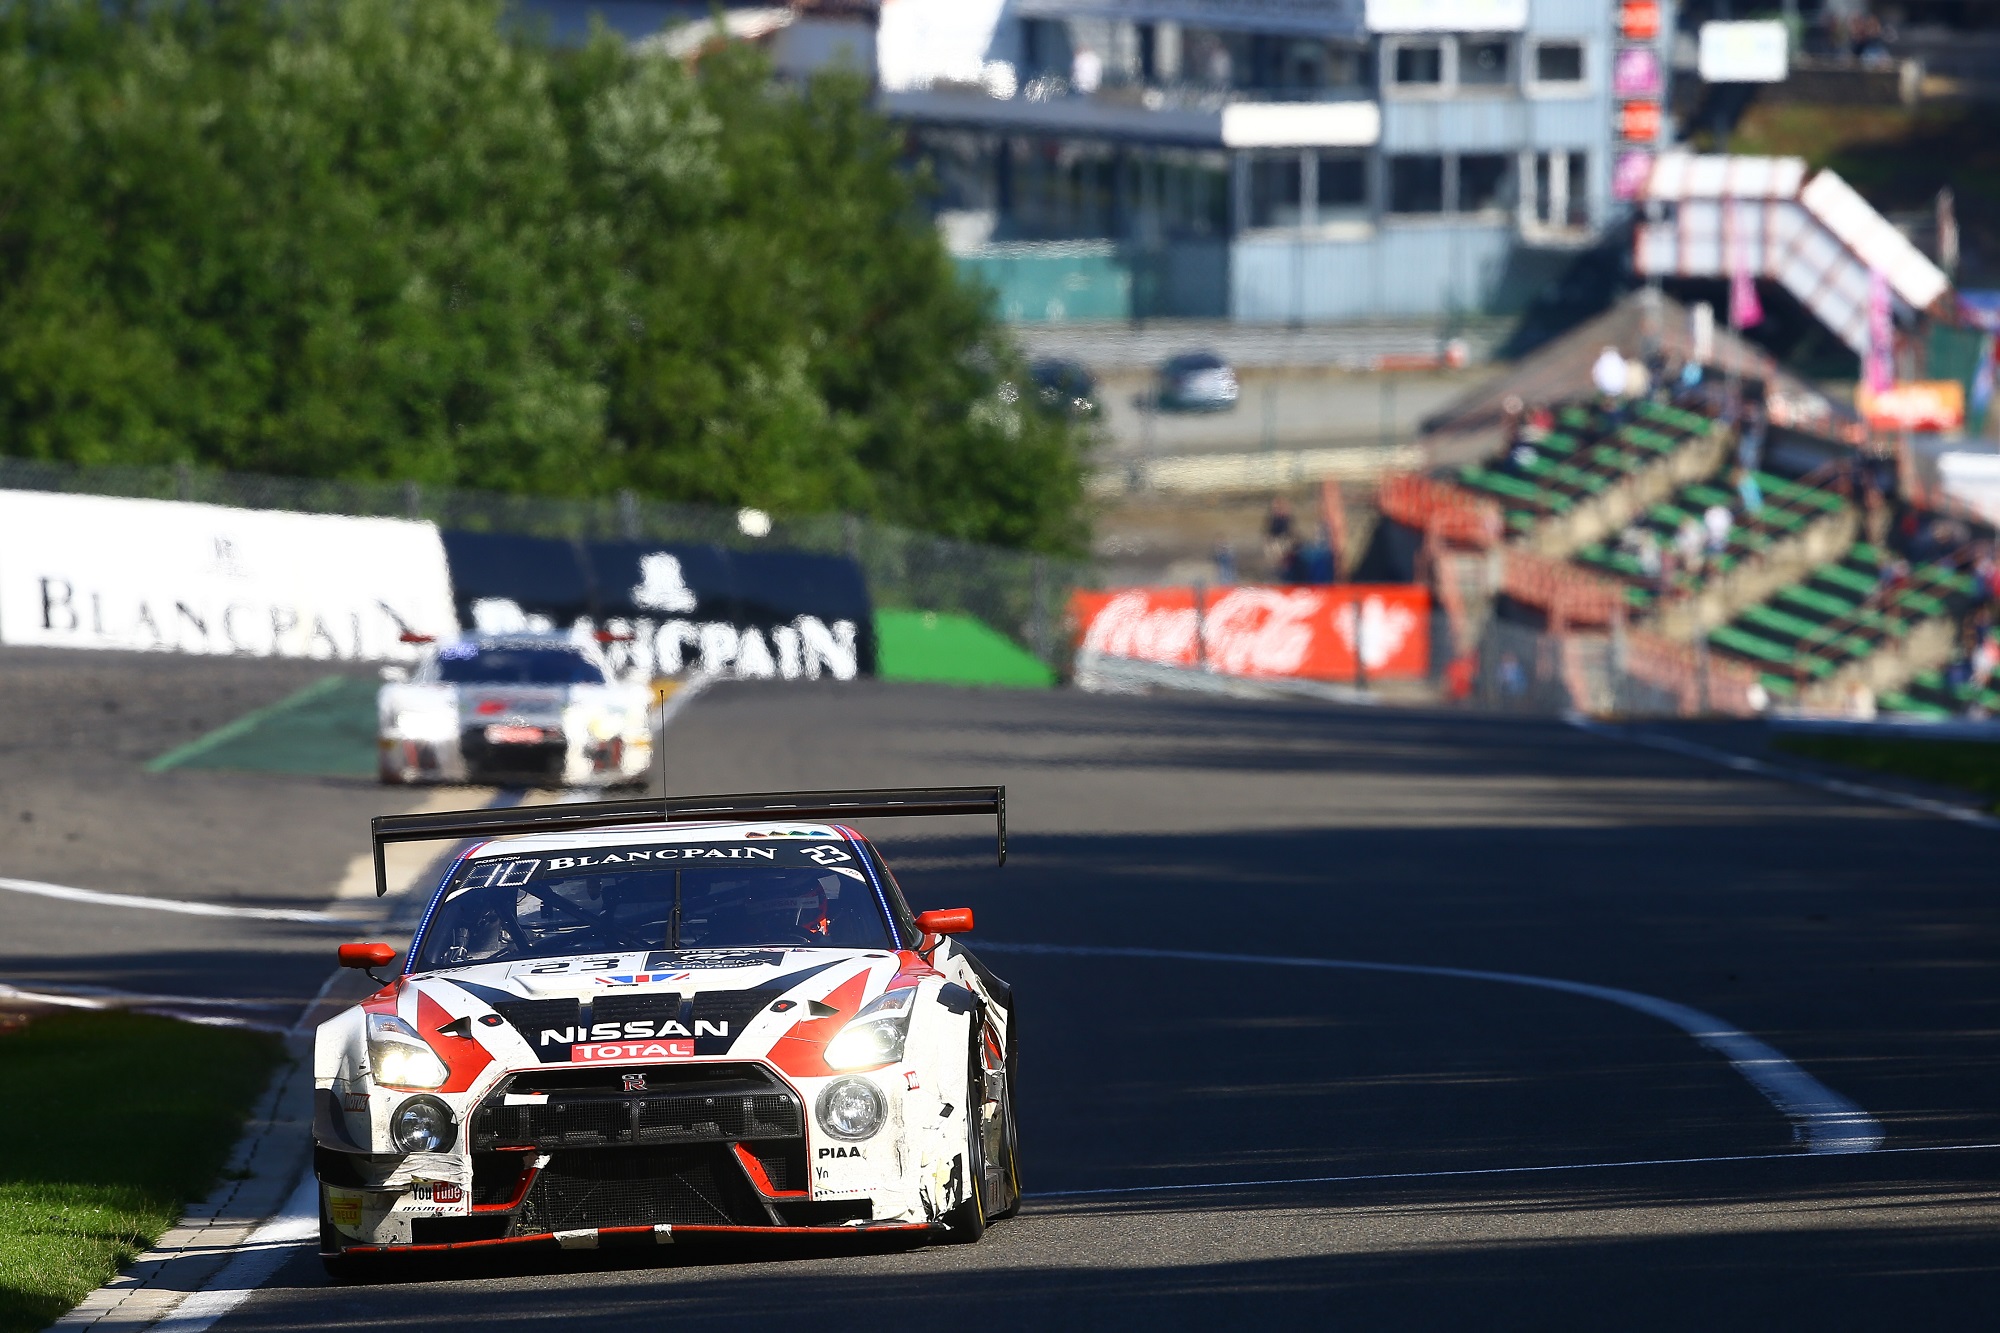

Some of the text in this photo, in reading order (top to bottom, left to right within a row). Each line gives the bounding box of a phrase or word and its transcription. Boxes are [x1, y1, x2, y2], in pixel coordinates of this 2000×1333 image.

[547, 846, 778, 871] BLANCPAIN
[800, 845, 852, 866] 23
[540, 1020, 729, 1046] NISSAN
[575, 1043, 691, 1060] TOTAL
[818, 1146, 861, 1159] PIAA
[412, 1182, 462, 1201] YouTube
